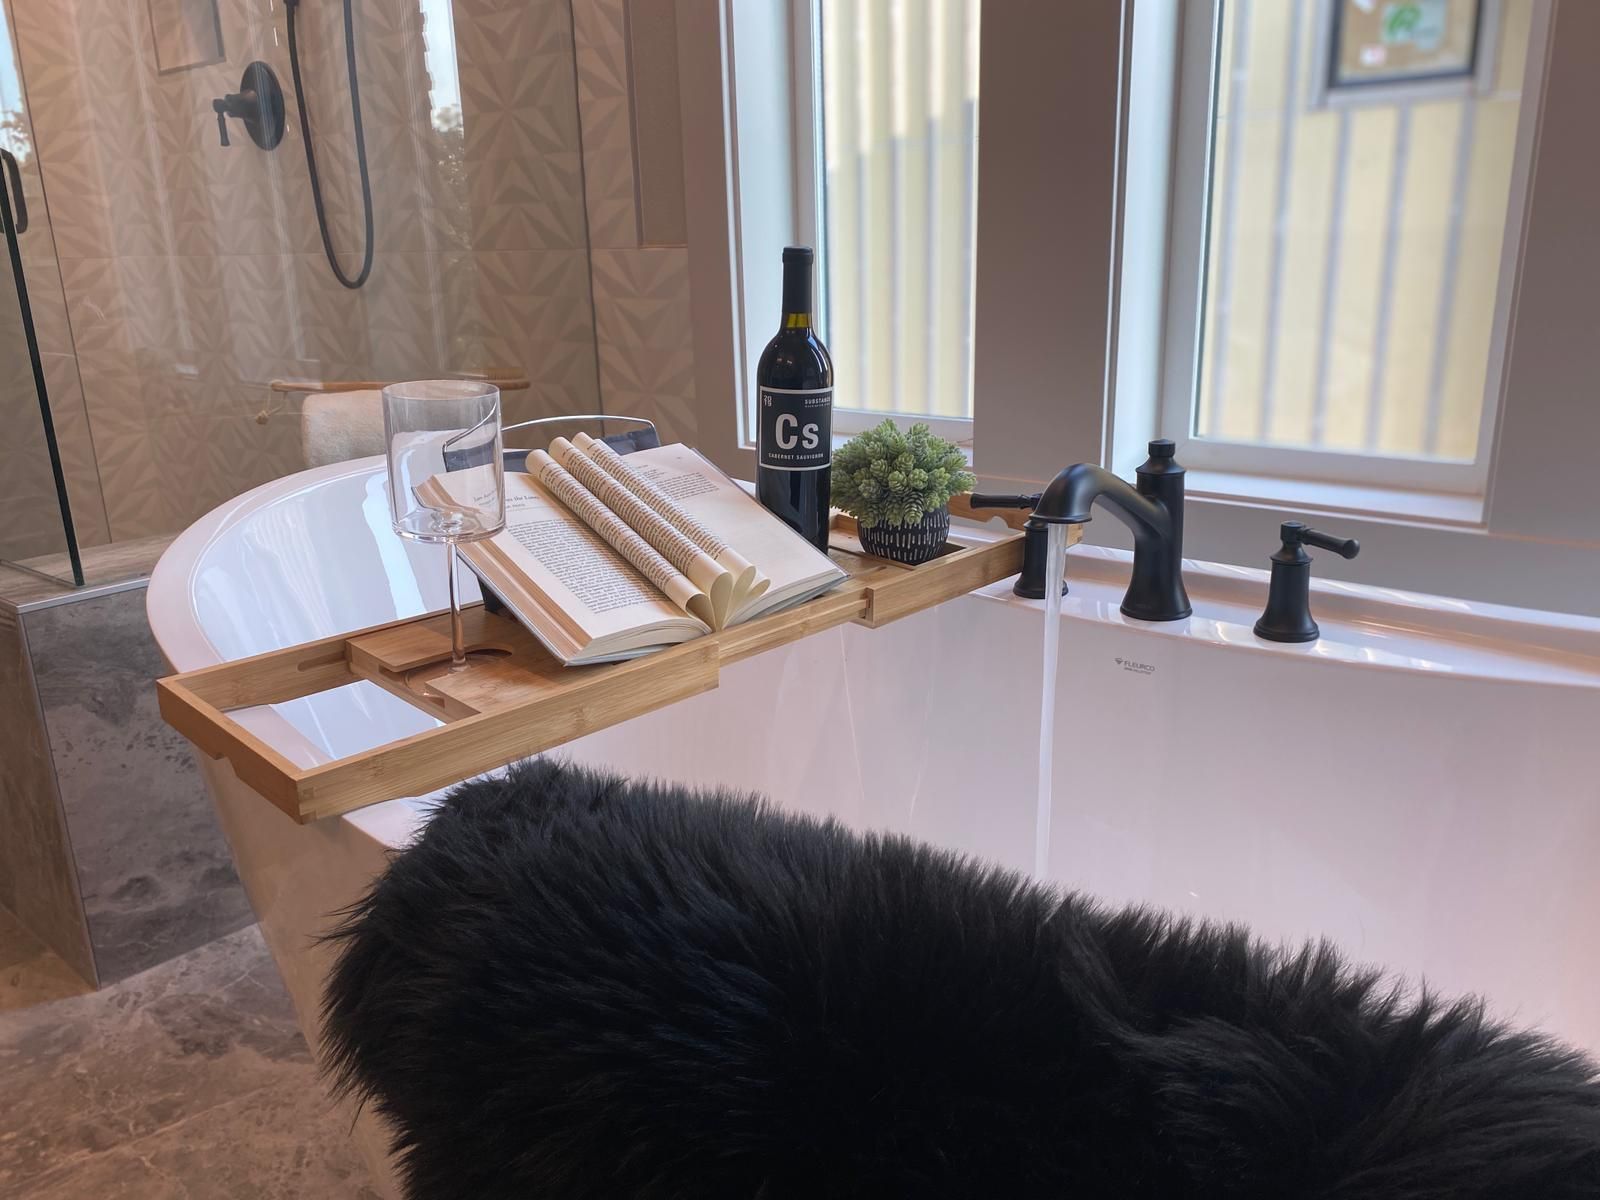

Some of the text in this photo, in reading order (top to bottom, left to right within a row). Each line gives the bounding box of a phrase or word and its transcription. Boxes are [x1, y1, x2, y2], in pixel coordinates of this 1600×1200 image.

[775, 413, 819, 450] Cs
[768, 452, 794, 460] CABERNET
[1123, 660, 1156, 671] FLEURCO
